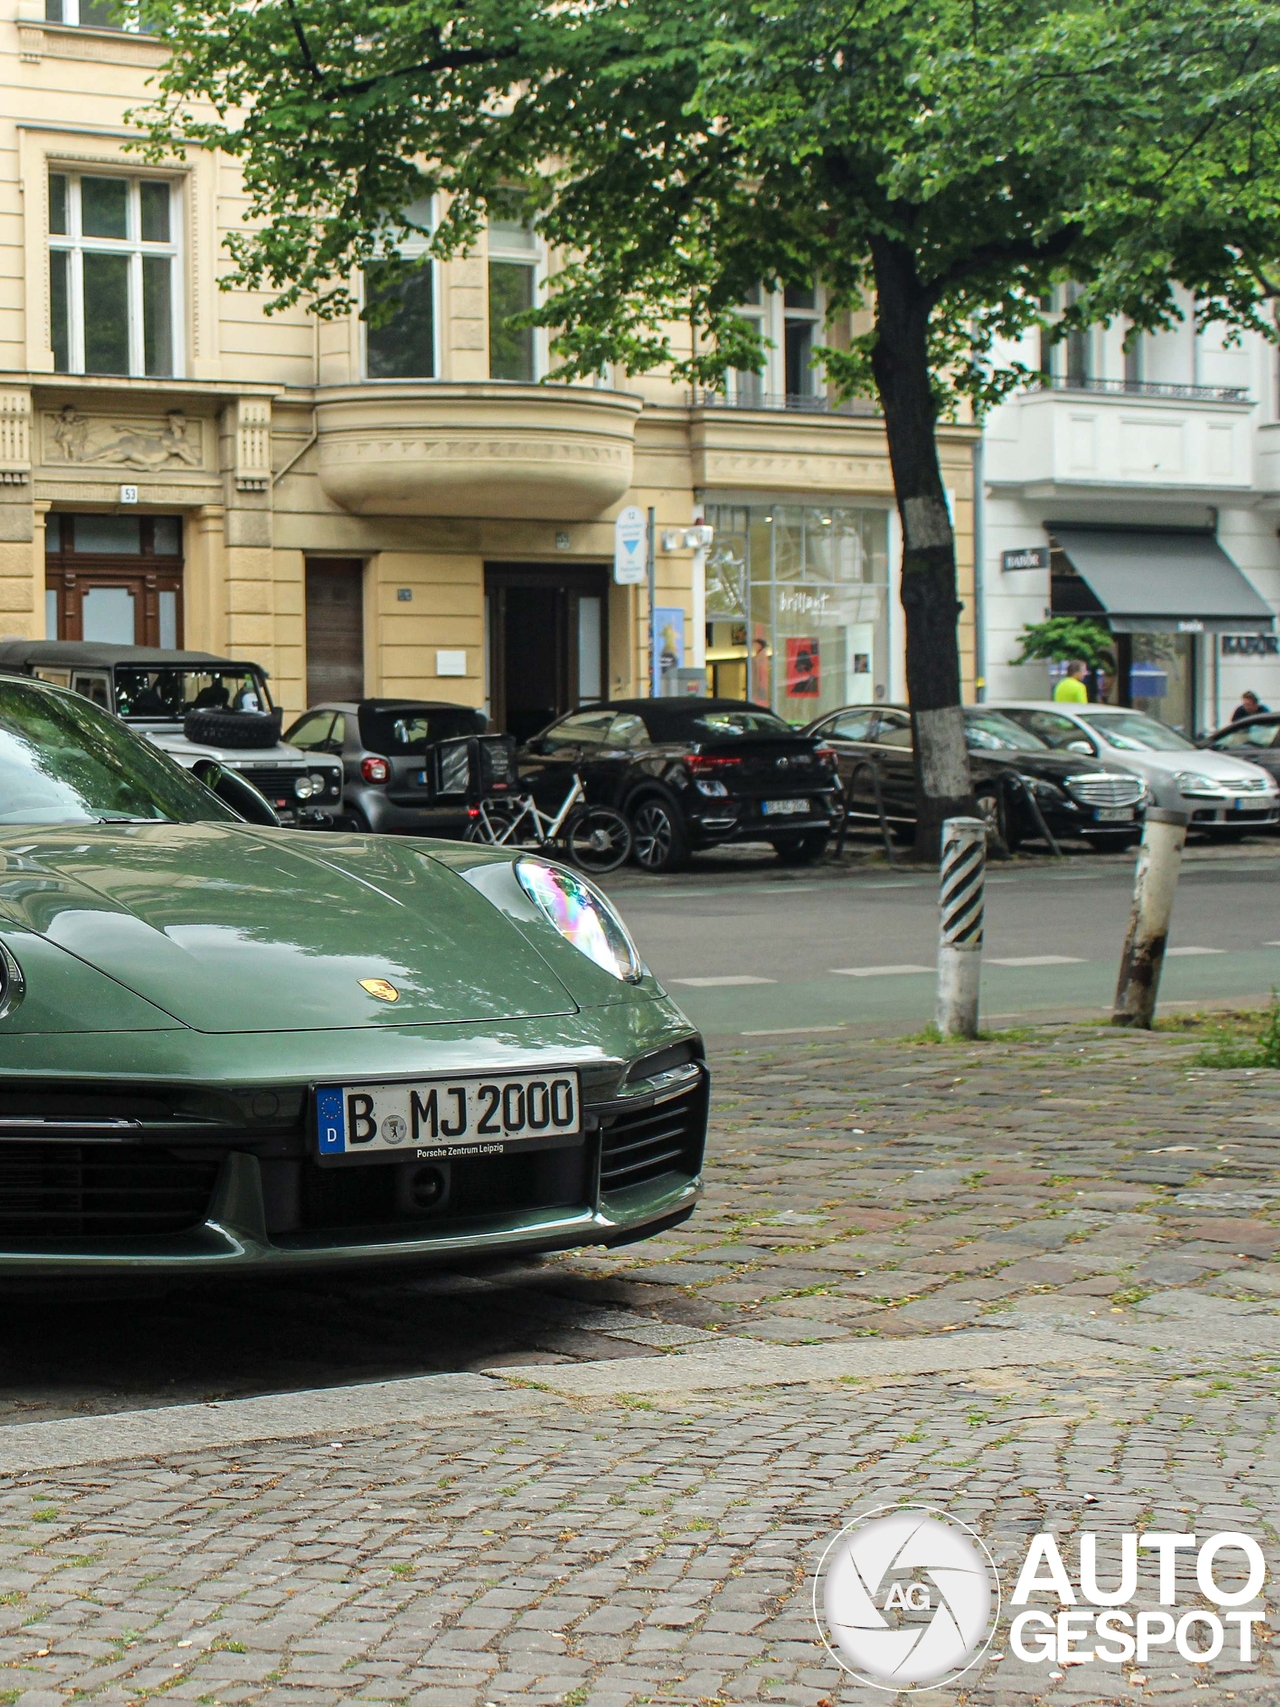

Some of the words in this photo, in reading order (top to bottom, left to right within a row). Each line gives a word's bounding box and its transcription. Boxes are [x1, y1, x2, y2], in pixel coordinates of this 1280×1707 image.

[126, 489, 136, 500] 53
[327, 1128, 337, 1143] D
[348, 1093, 377, 1144] B
[410, 1087, 467, 1139] MJ
[477, 1080, 574, 1135] 2000
[416, 1148, 447, 1158] Porsche
[448, 1146, 478, 1156] Zentrum
[479, 1143, 504, 1155] Leipzig
